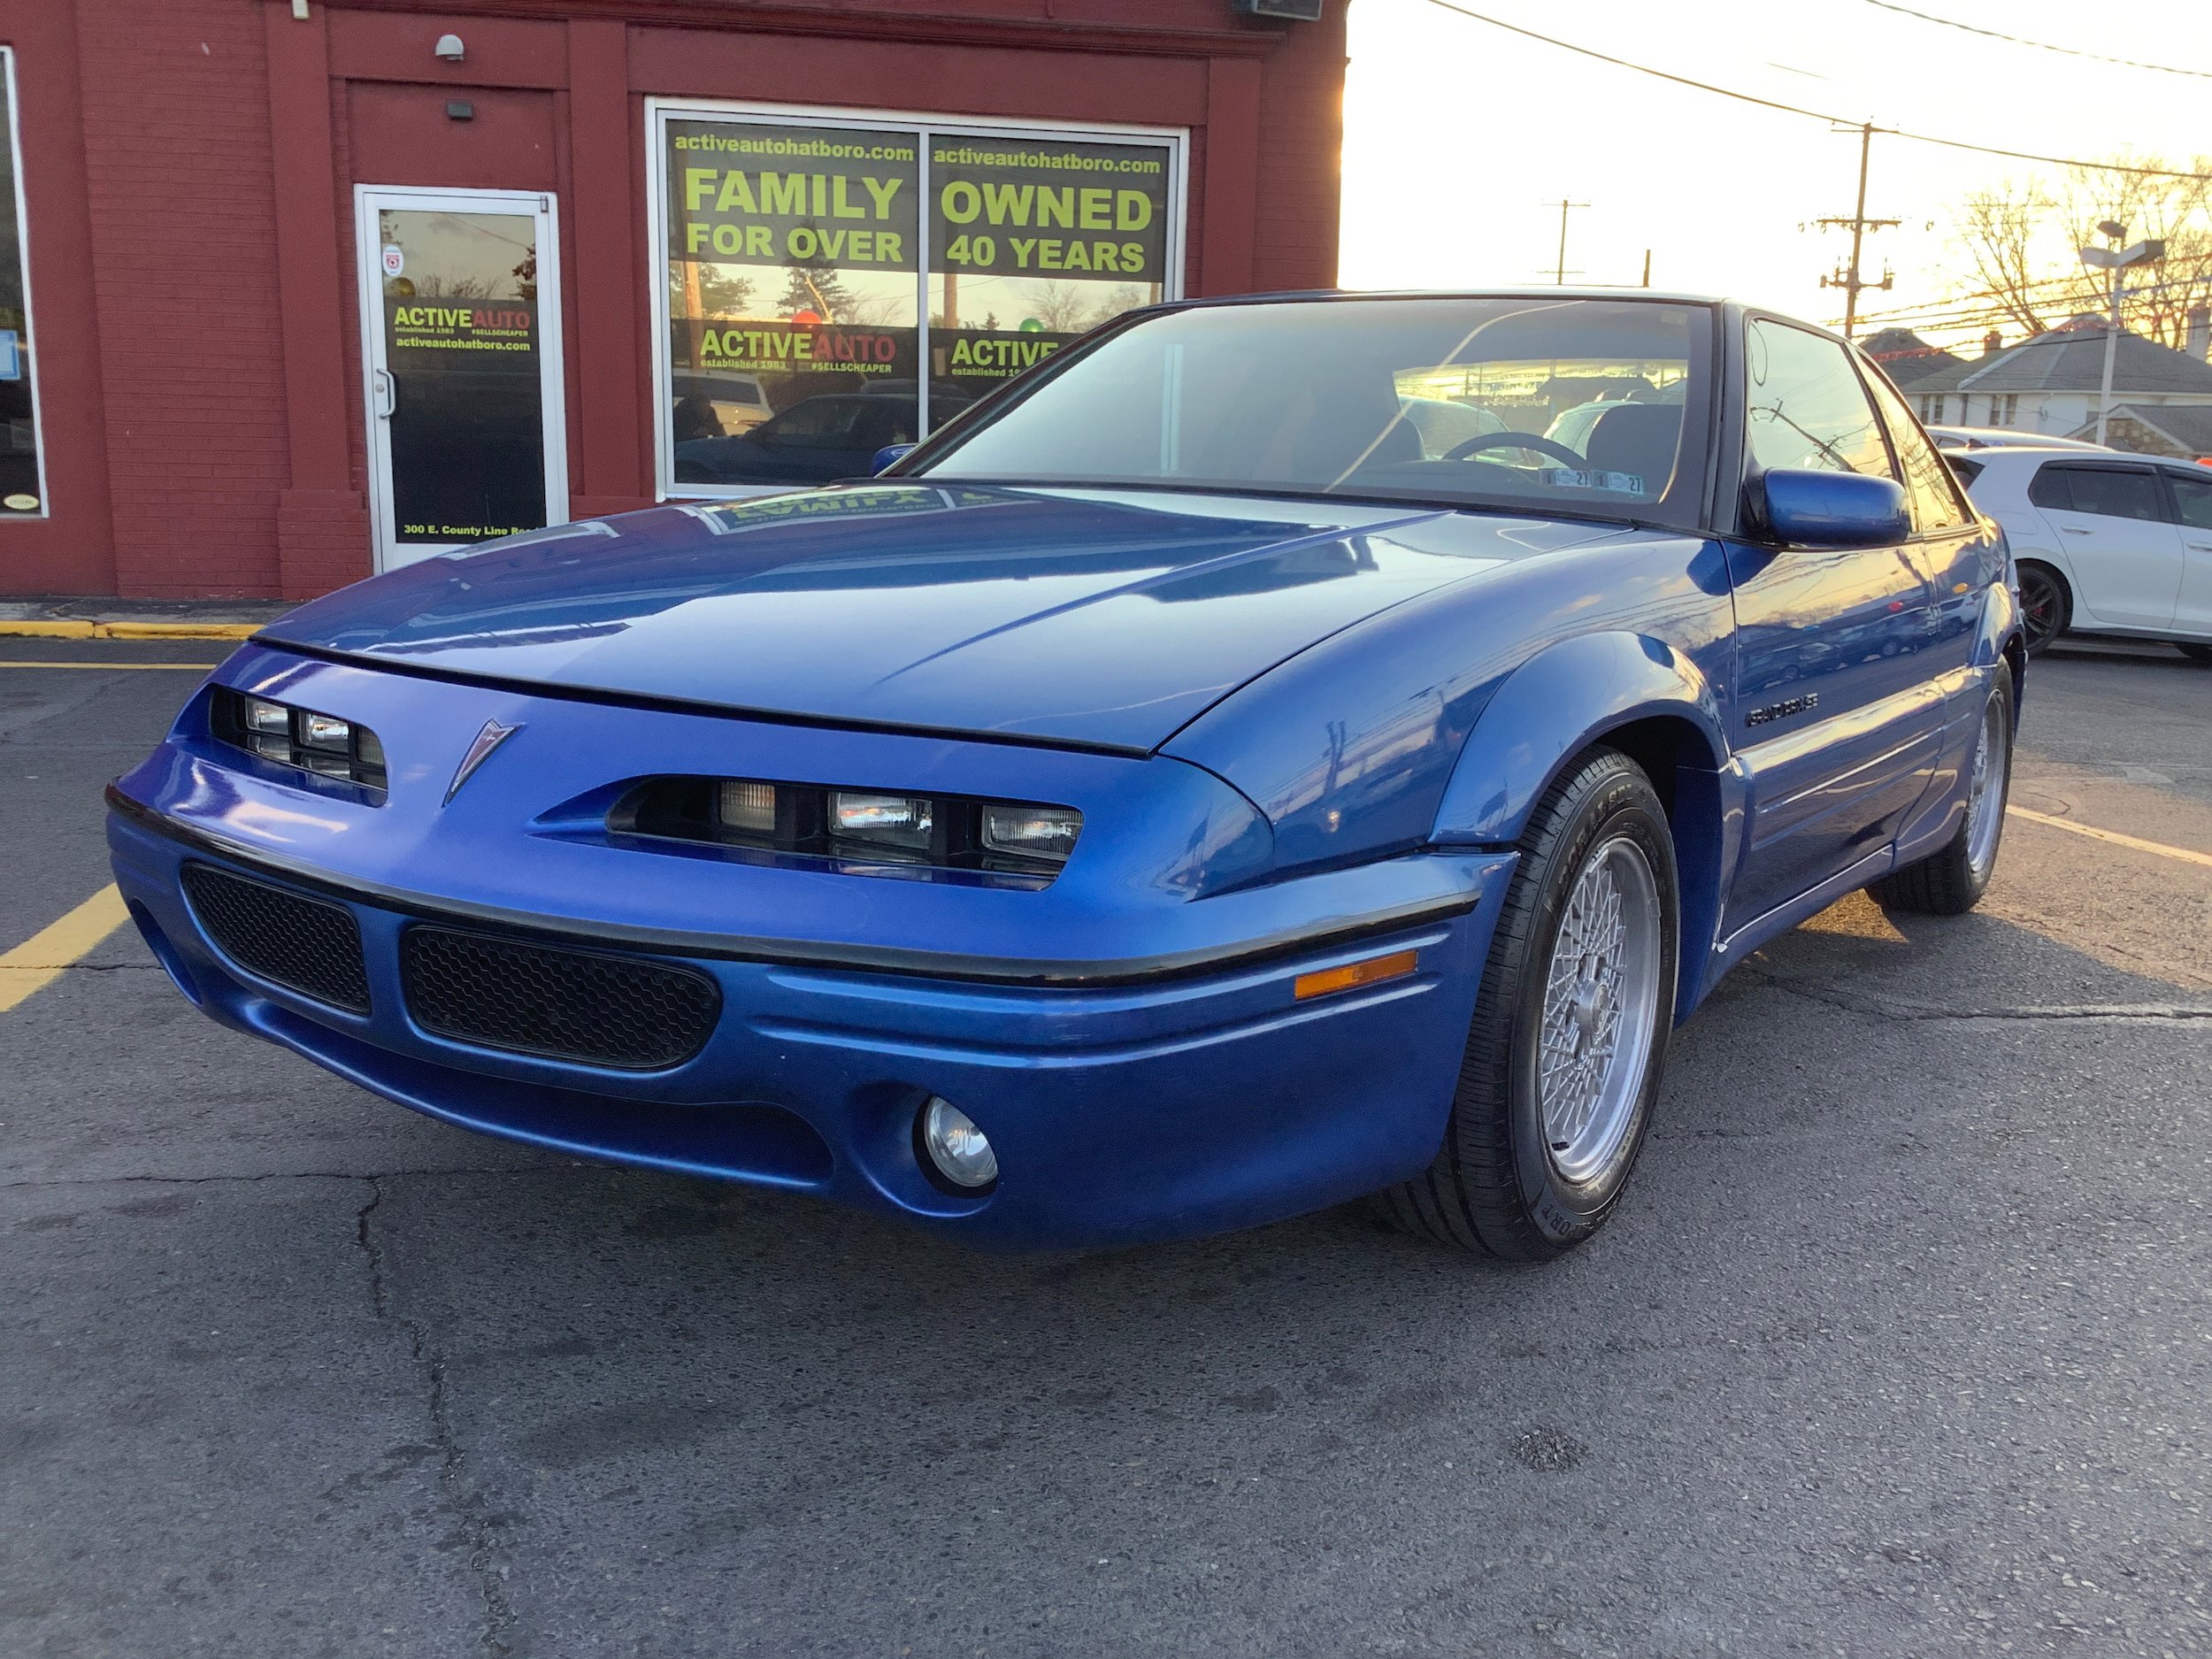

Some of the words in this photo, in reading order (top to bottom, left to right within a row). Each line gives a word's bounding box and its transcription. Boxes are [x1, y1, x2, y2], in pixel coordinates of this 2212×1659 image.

[675, 134, 914, 161] activeautohatboro.com
[933, 148, 1161, 173] activeautohatboro.com
[685, 167, 903, 219] FAMILY
[941, 180, 1152, 231] OWNED
[687, 223, 774, 257] FOR
[787, 227, 902, 263] OVER
[946, 234, 996, 266] 40
[1009, 237, 1145, 273] YEARS
[396, 336, 531, 351] activeautohatboro.com
[701, 359, 758, 370] established
[760, 359, 787, 370] 1983
[811, 361, 893, 373] #SELLSCHEAPER
[951, 367, 1006, 377] established
[403, 525, 425, 534] 300
[428, 525, 439, 534] E.
[442, 525, 481, 537] County
[484, 526, 508, 536] Line
